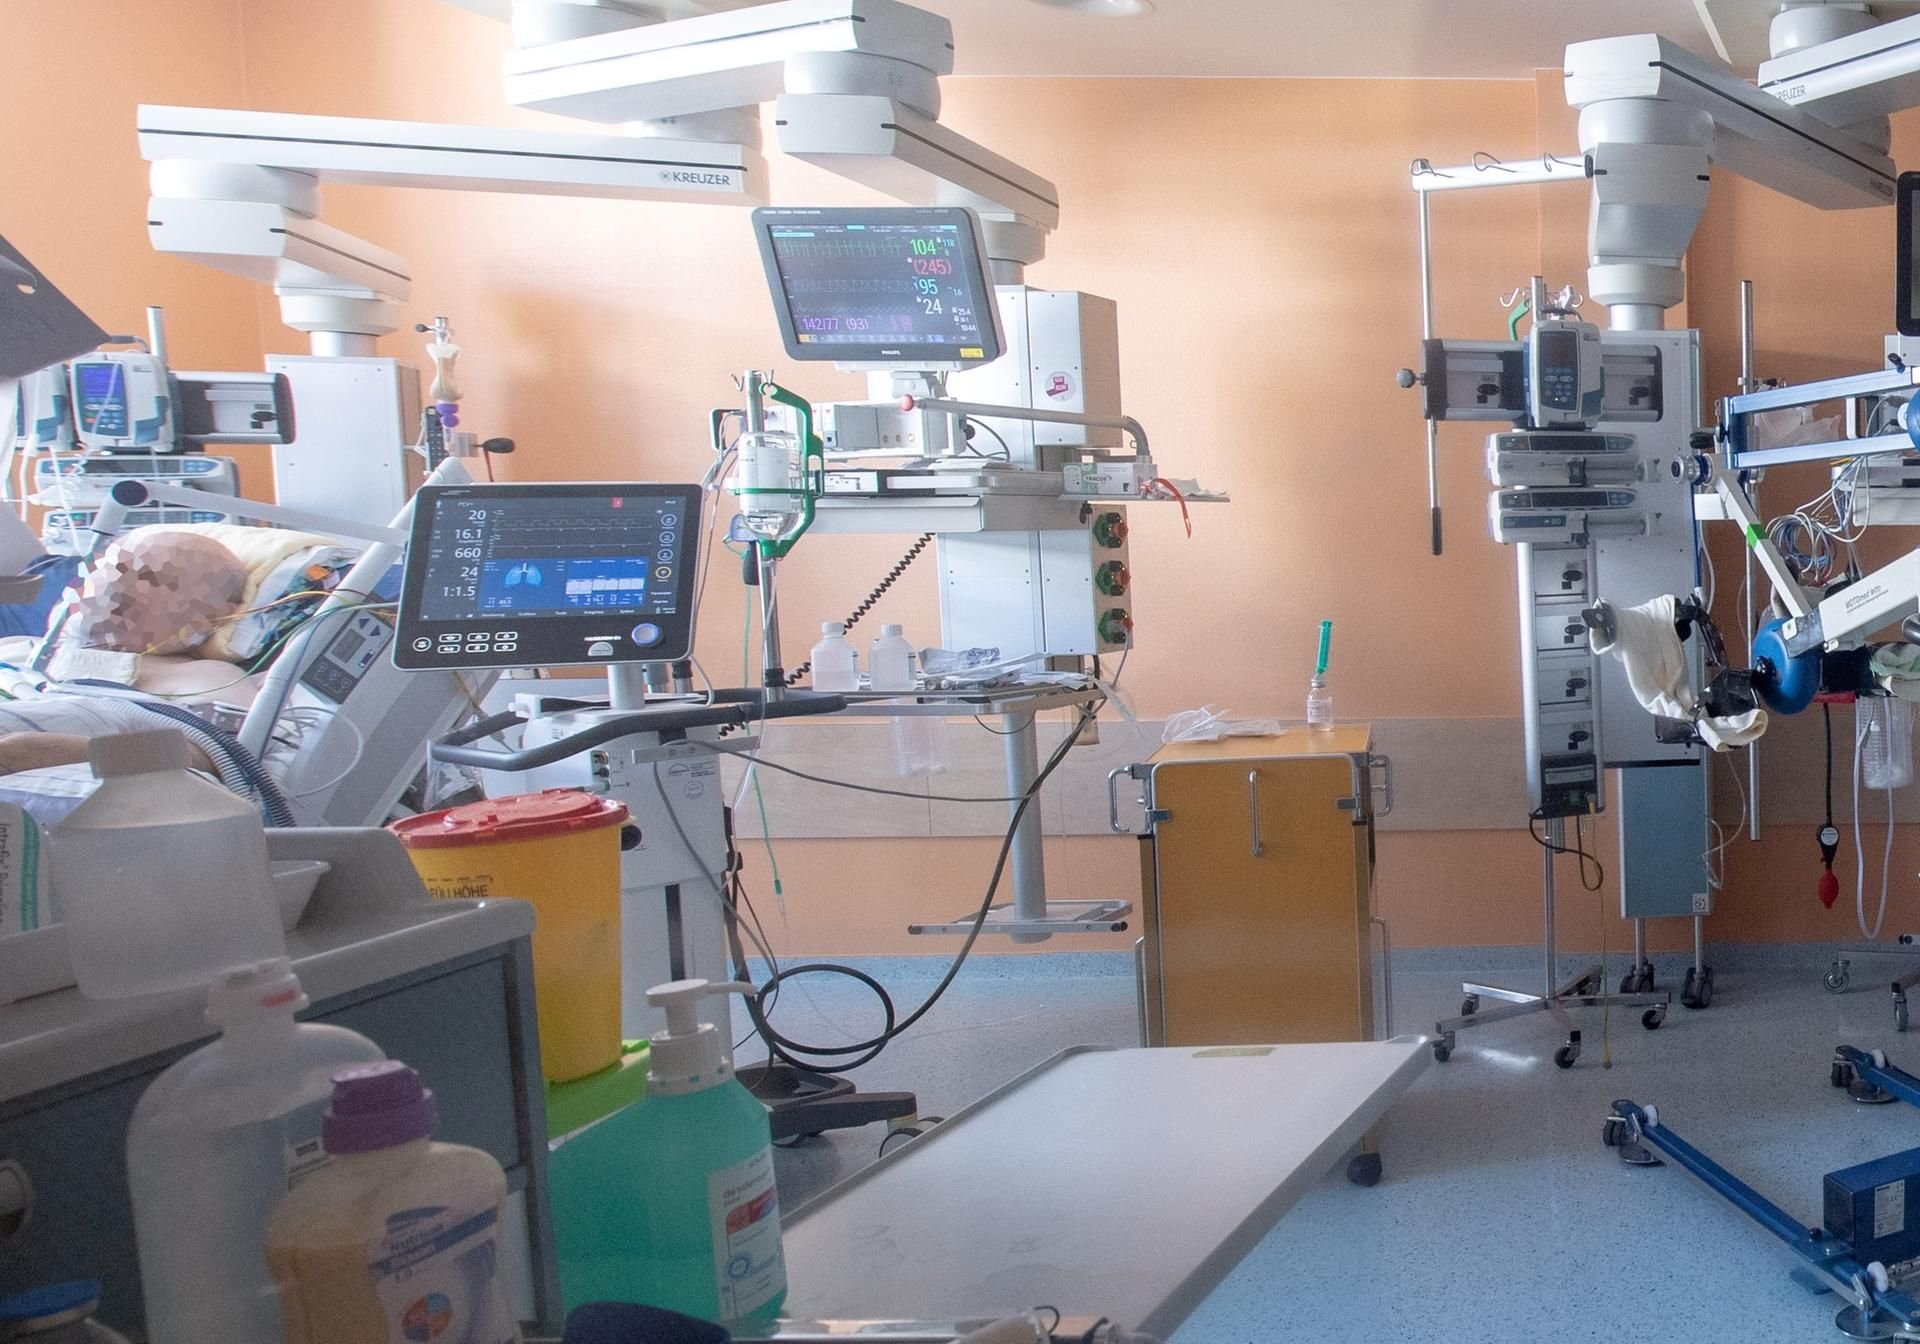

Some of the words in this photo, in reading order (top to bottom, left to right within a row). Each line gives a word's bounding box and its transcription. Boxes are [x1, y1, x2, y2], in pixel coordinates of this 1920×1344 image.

[1776, 84, 1807, 101] REUZER
[673, 171, 731, 186] KREUZER
[909, 238, 936, 256] 104
[913, 258, 952, 276] (245)
[919, 278, 938, 295] 95
[922, 298, 943, 315] 24
[846, 318, 869, 331] (93)
[468, 509, 487, 520] 20
[455, 528, 482, 539] 16.1
[454, 547, 481, 559] 660
[460, 566, 479, 577] 24
[443, 586, 476, 597] 1:1.5
